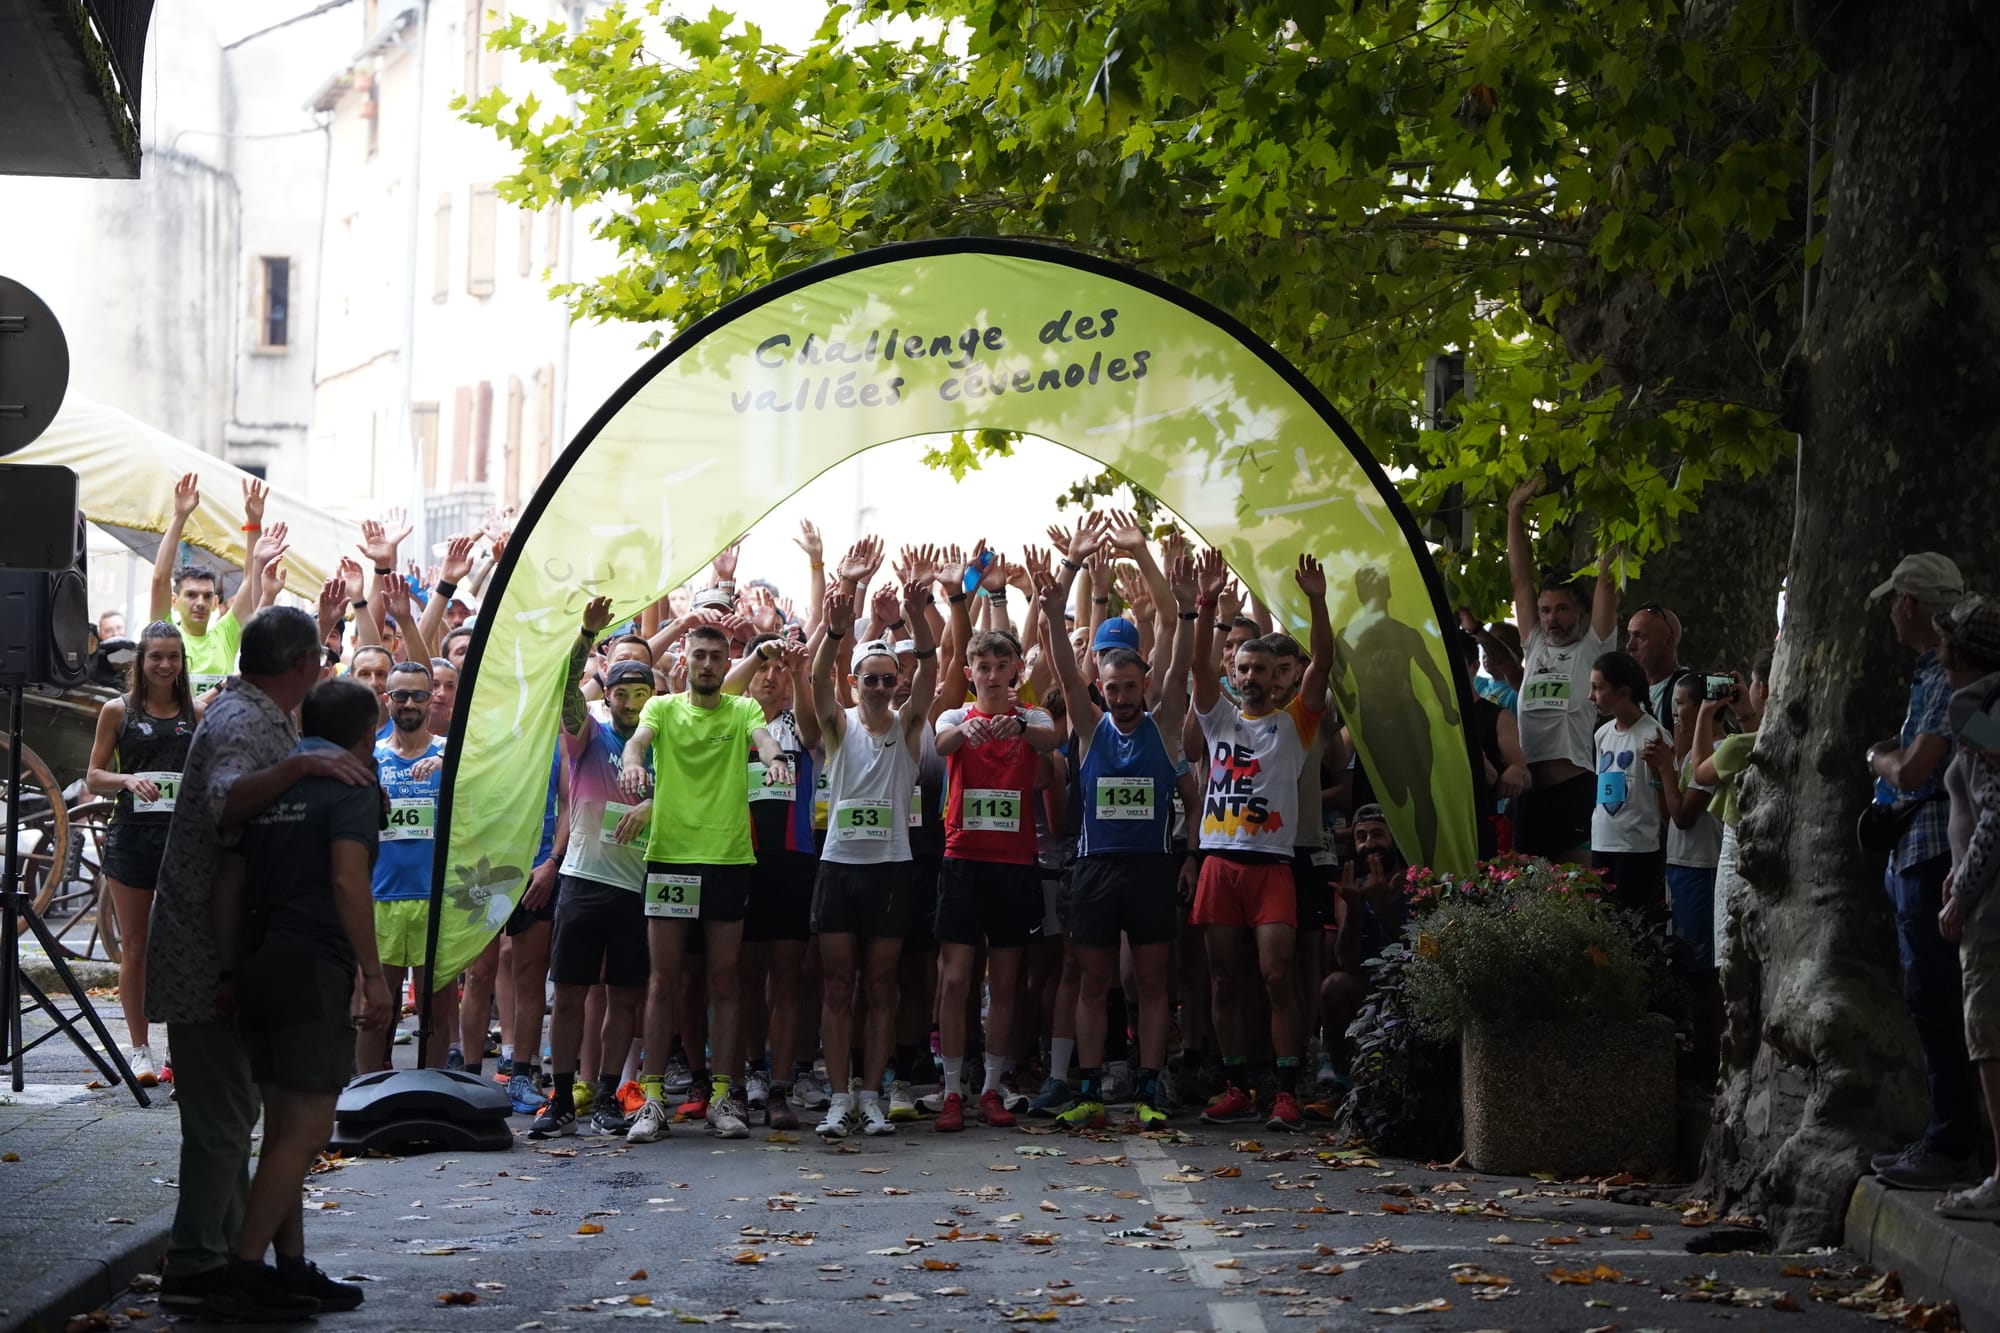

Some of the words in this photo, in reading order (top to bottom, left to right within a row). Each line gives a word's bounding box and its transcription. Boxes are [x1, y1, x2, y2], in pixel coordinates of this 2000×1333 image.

[755, 326, 1007, 369] Challenge
[1038, 307, 1119, 344] des
[731, 371, 905, 414] vallées
[938, 350, 1151, 401] cévenoles
[1530, 682, 1563, 698] 117
[1214, 741, 1254, 768] DE
[1209, 769, 1253, 795] ME
[1605, 784, 1613, 796] 5
[1105, 788, 1147, 805] 134
[972, 800, 1013, 817] 113
[1206, 797, 1268, 823] NTS
[391, 809, 420, 826] 46
[852, 809, 879, 826] 53
[657, 885, 684, 903] 43
